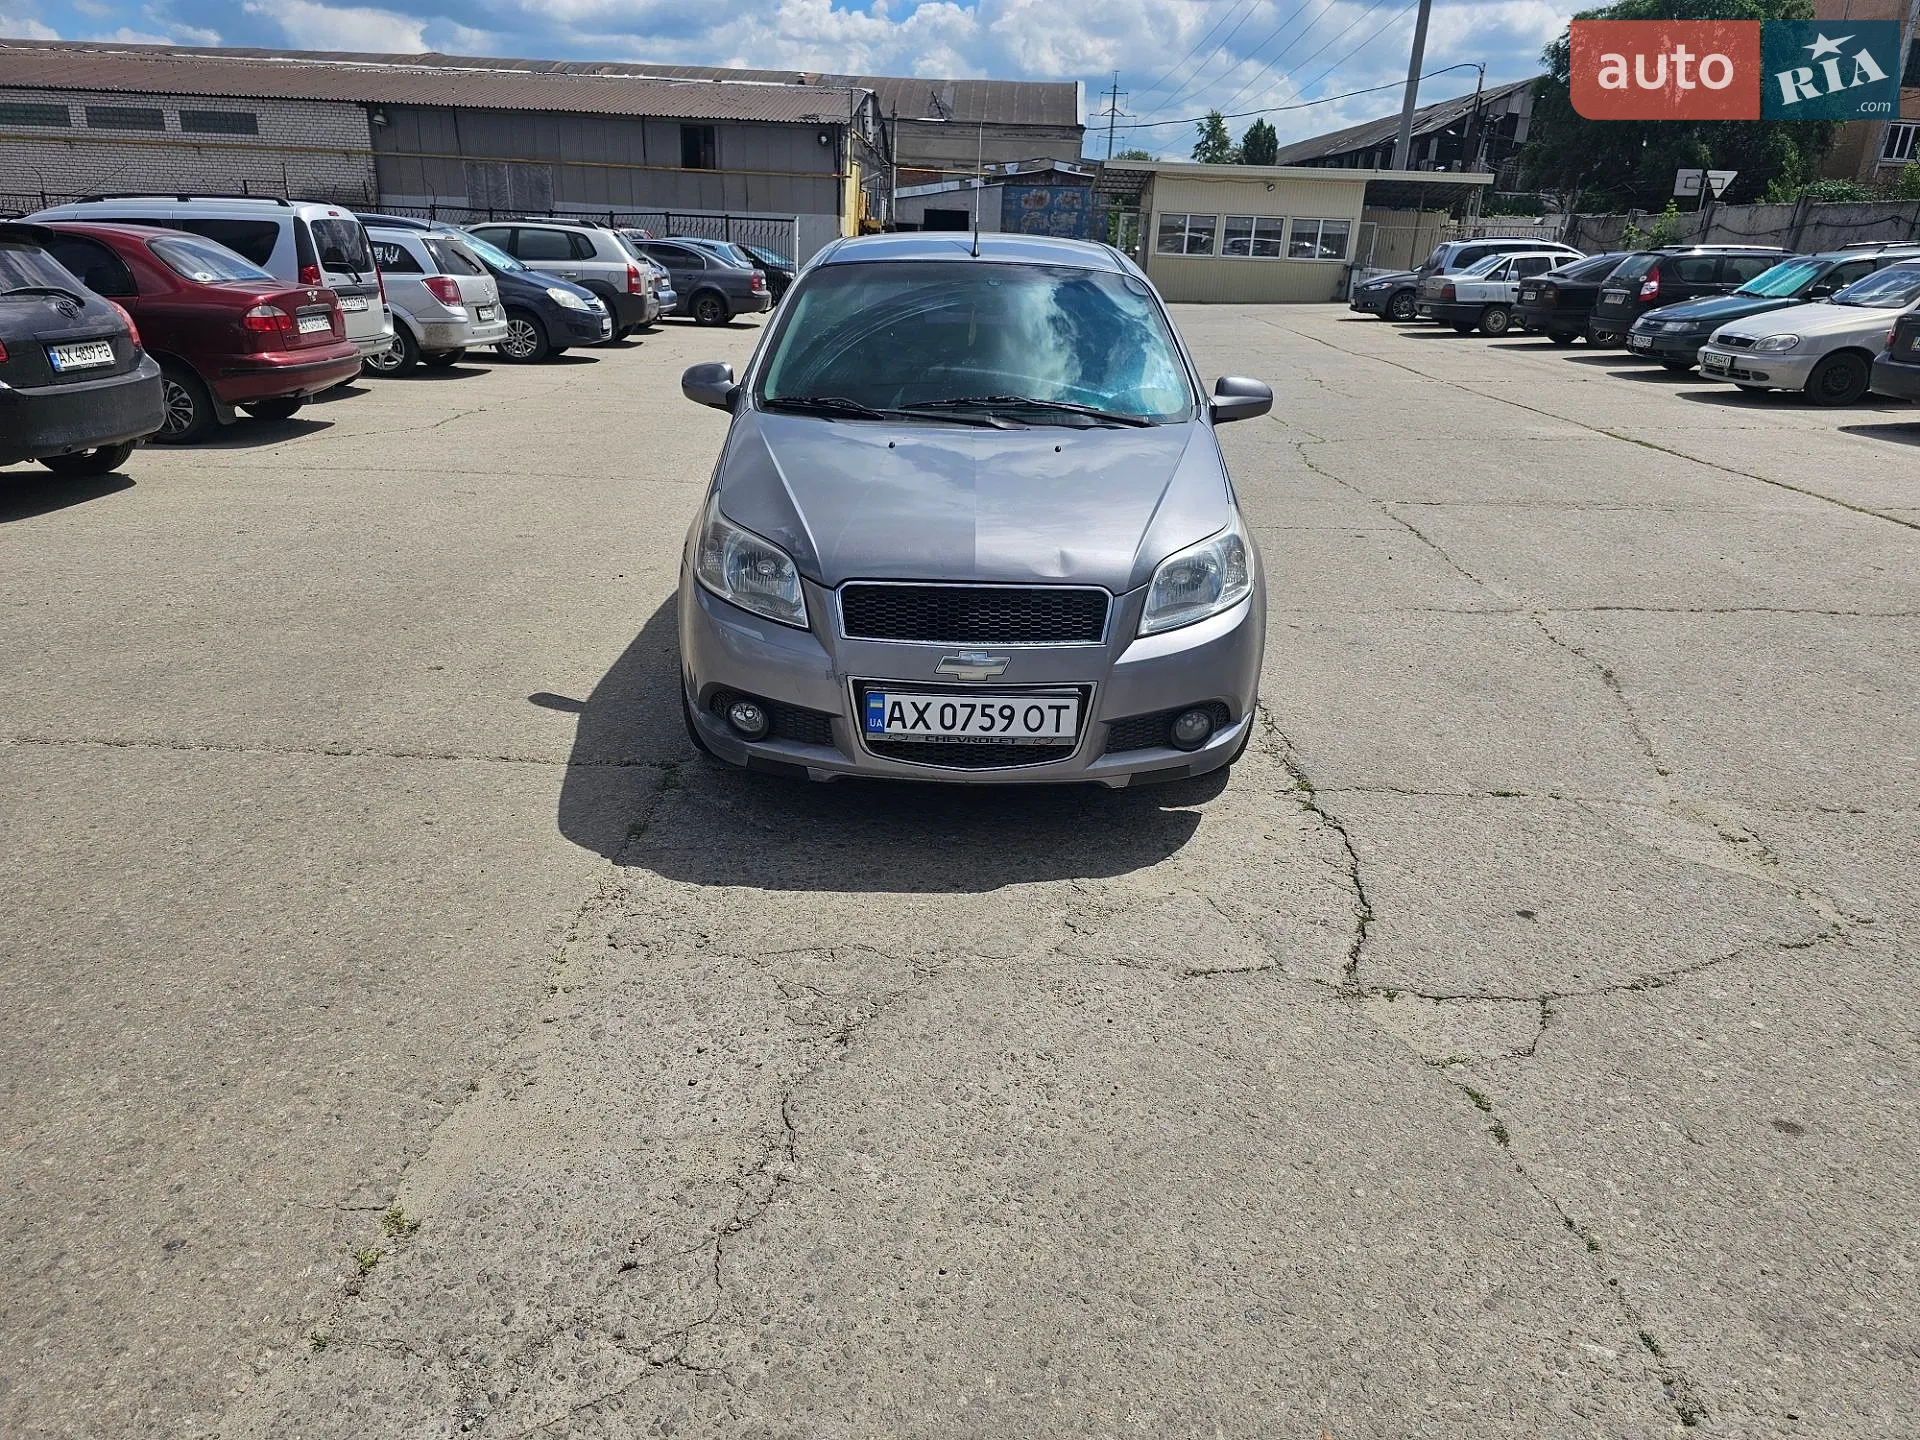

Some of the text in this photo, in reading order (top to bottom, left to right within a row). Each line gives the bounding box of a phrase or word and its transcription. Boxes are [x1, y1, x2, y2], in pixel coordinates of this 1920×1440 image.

[57, 347, 75, 364] AX
[870, 718, 883, 728] UA
[885, 700, 1070, 733] AX 0759 OT
[925, 735, 1019, 745] CHEVROLET
